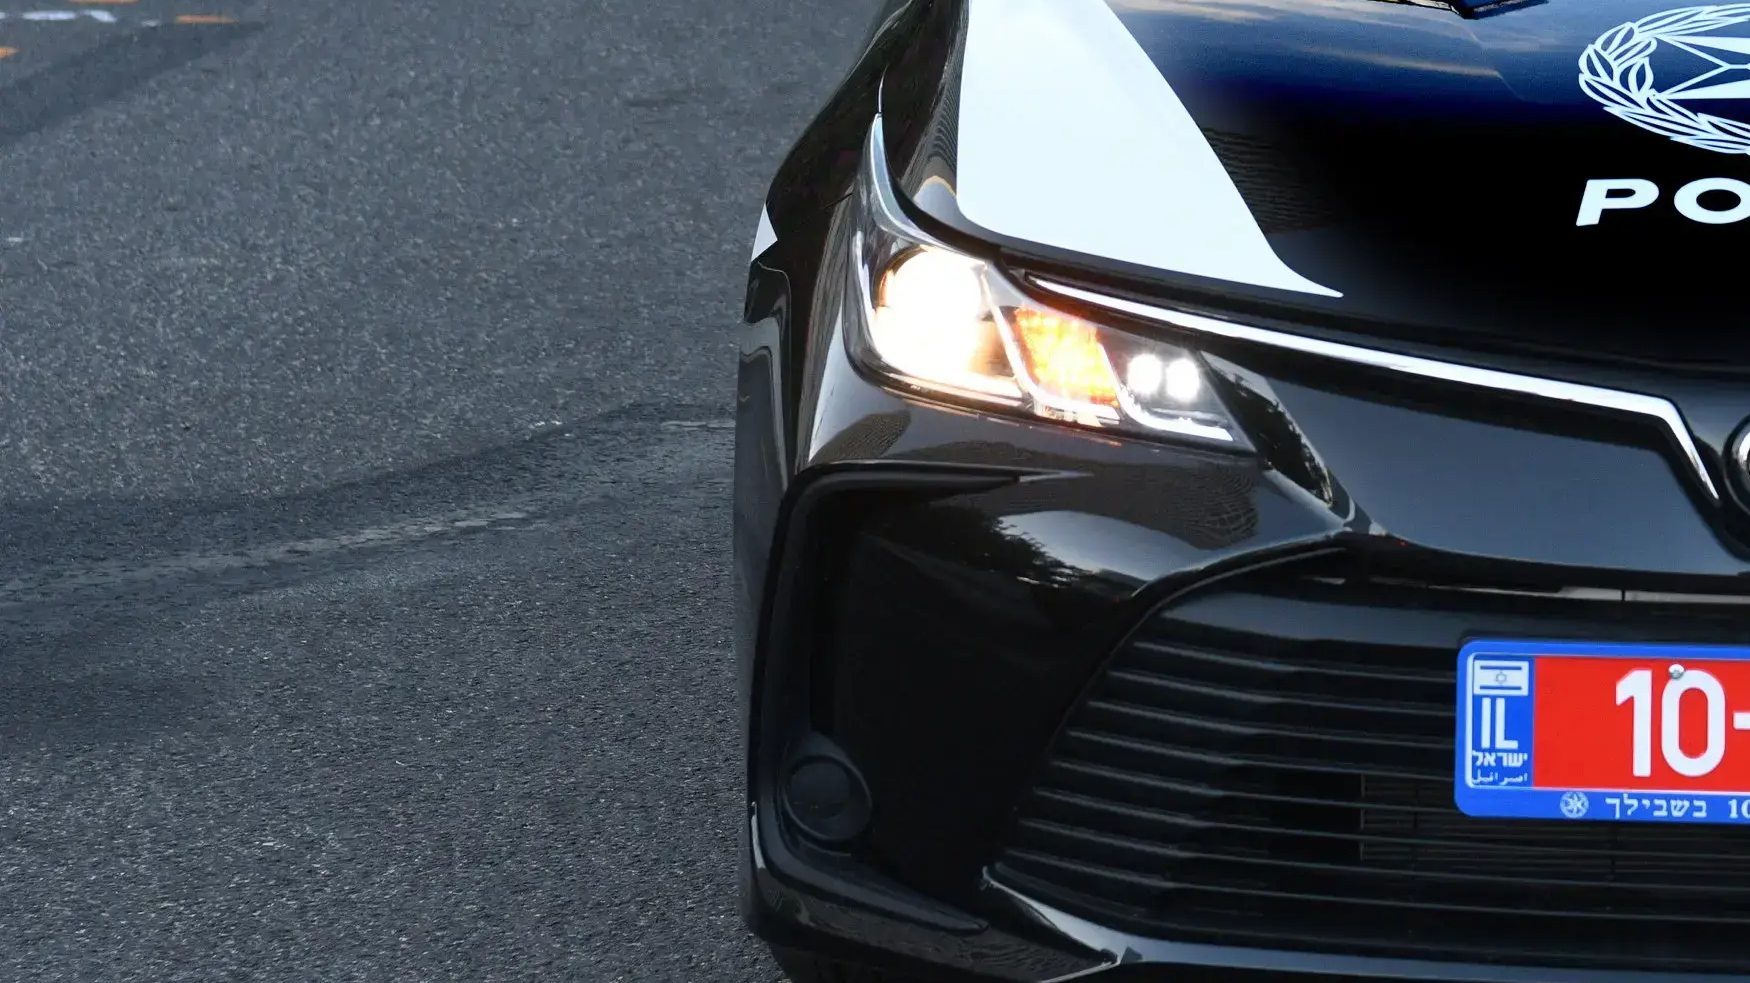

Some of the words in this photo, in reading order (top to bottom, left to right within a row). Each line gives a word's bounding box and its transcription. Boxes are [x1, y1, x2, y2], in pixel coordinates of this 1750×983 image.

[1481, 698, 1518, 749] IL
[1472, 750, 1528, 767] ישראל
[1606, 796, 1708, 818] בשבילך
